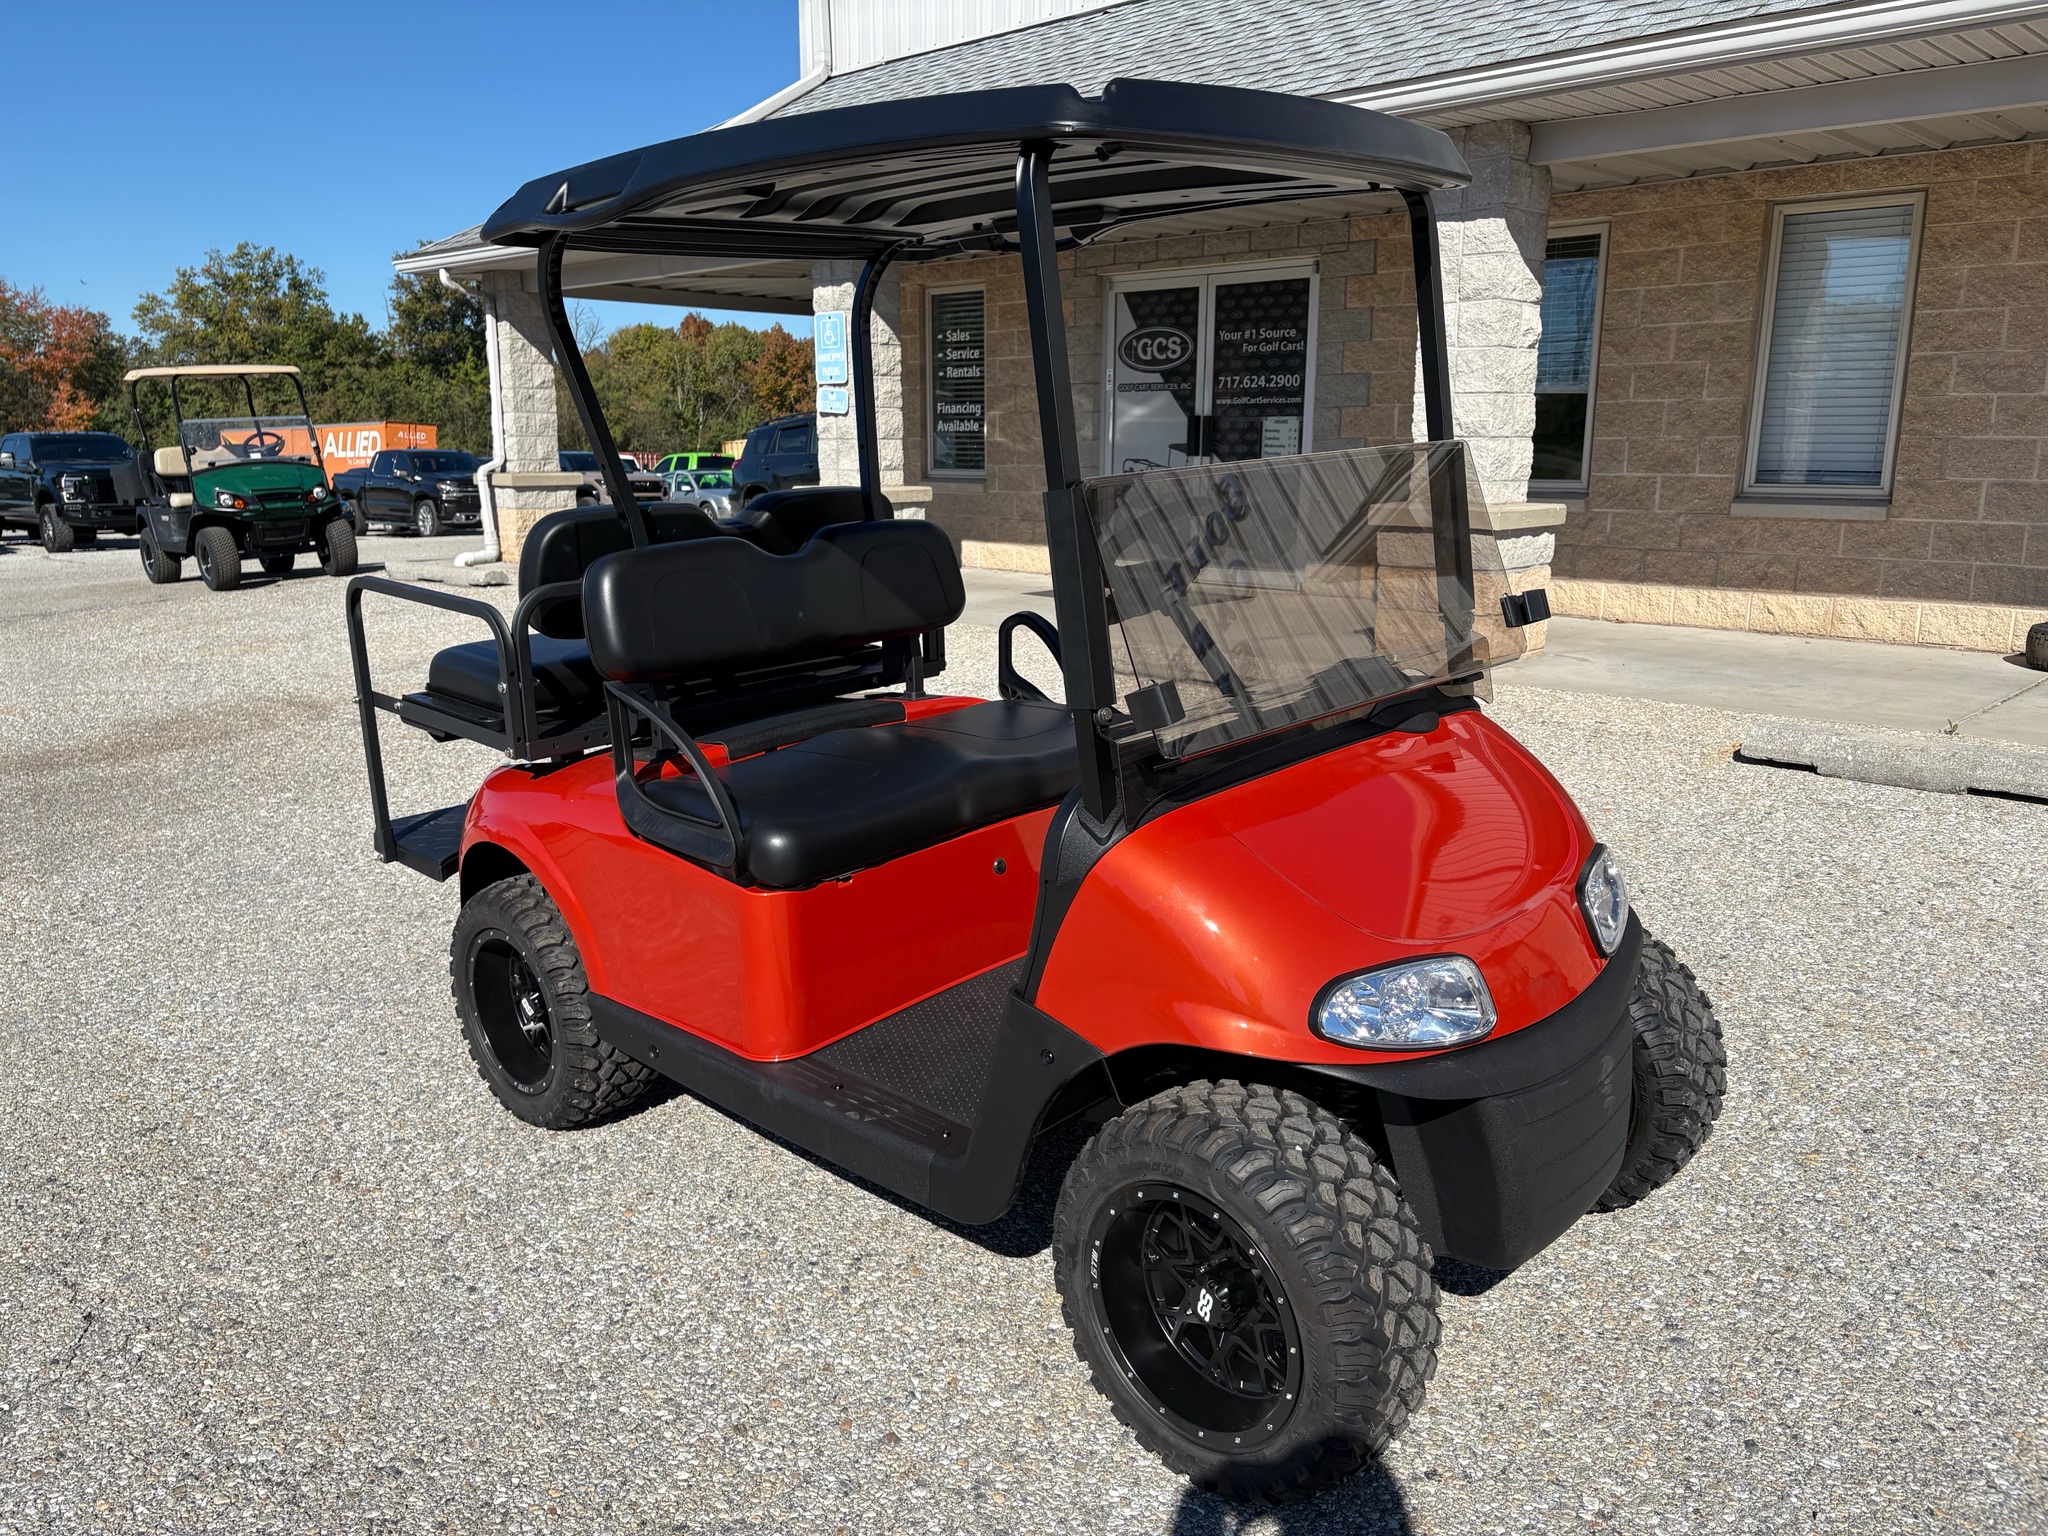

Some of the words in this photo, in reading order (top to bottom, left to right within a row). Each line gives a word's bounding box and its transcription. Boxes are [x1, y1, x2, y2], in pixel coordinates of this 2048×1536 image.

[946, 329, 970, 342] Sales
[1219, 330, 1242, 341] Your
[1244, 328, 1256, 340] #1
[1259, 328, 1297, 339] Source
[1137, 336, 1182, 360] GCS
[1242, 343, 1258, 353] For
[1259, 342, 1280, 352] Golf
[1281, 340, 1304, 351] Cars!
[946, 347, 980, 360] Service
[946, 365, 981, 378] Rentals
[1118, 383, 1134, 392] GOLF
[1134, 383, 1149, 391] CART
[1218, 374, 1300, 389] 717.624.2900
[1216, 396, 1301, 405] www.GolfCartServices.com
[937, 402, 981, 416] Financing
[937, 420, 979, 432] Available
[323, 430, 381, 459] ALLIED
